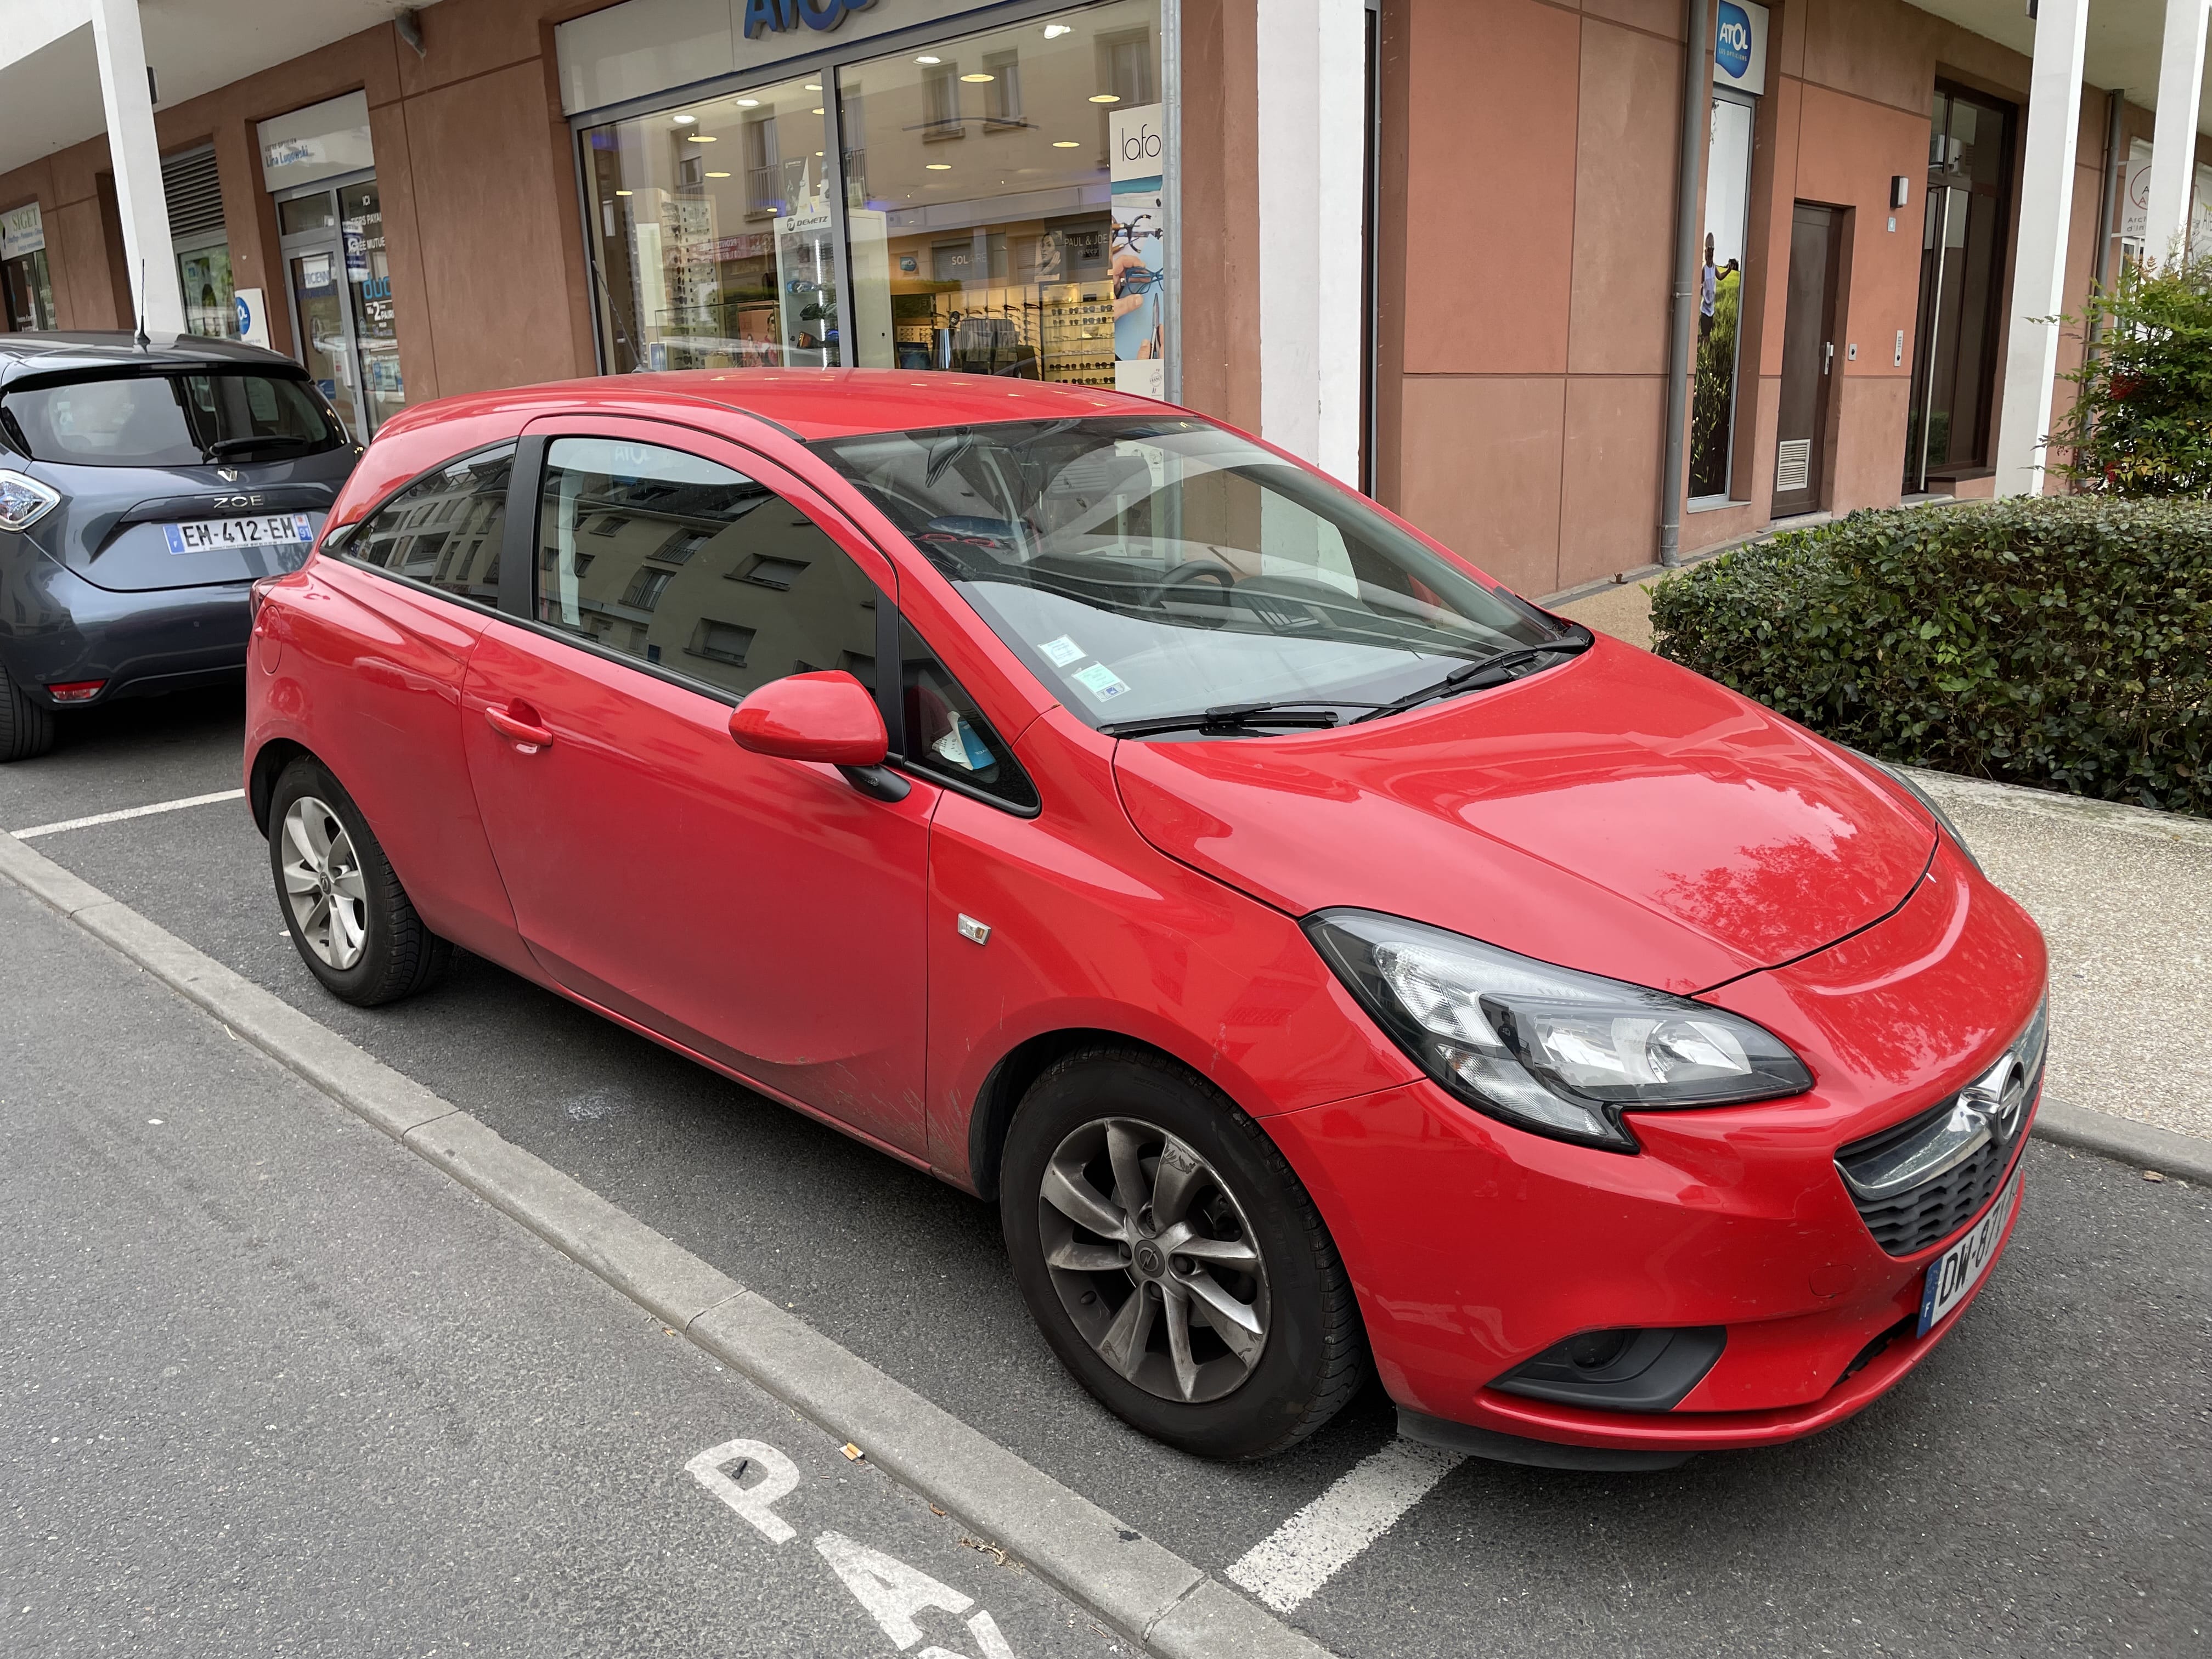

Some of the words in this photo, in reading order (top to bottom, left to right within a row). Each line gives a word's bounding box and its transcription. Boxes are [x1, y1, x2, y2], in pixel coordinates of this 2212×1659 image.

[1719, 22, 1748, 51] ATOL
[1121, 123, 1161, 162] lafo
[12, 208, 37, 232] SIGET
[797, 216, 828, 227] DEMETZ
[1064, 236, 1083, 247] PAUL
[1086, 235, 1091, 245] &
[1094, 234, 1107, 245] JOE
[952, 252, 987, 266] SOLAIRE
[214, 495, 263, 509] ZOE
[182, 517, 296, 547] EM-412-EM
[299, 528, 311, 538] 91
